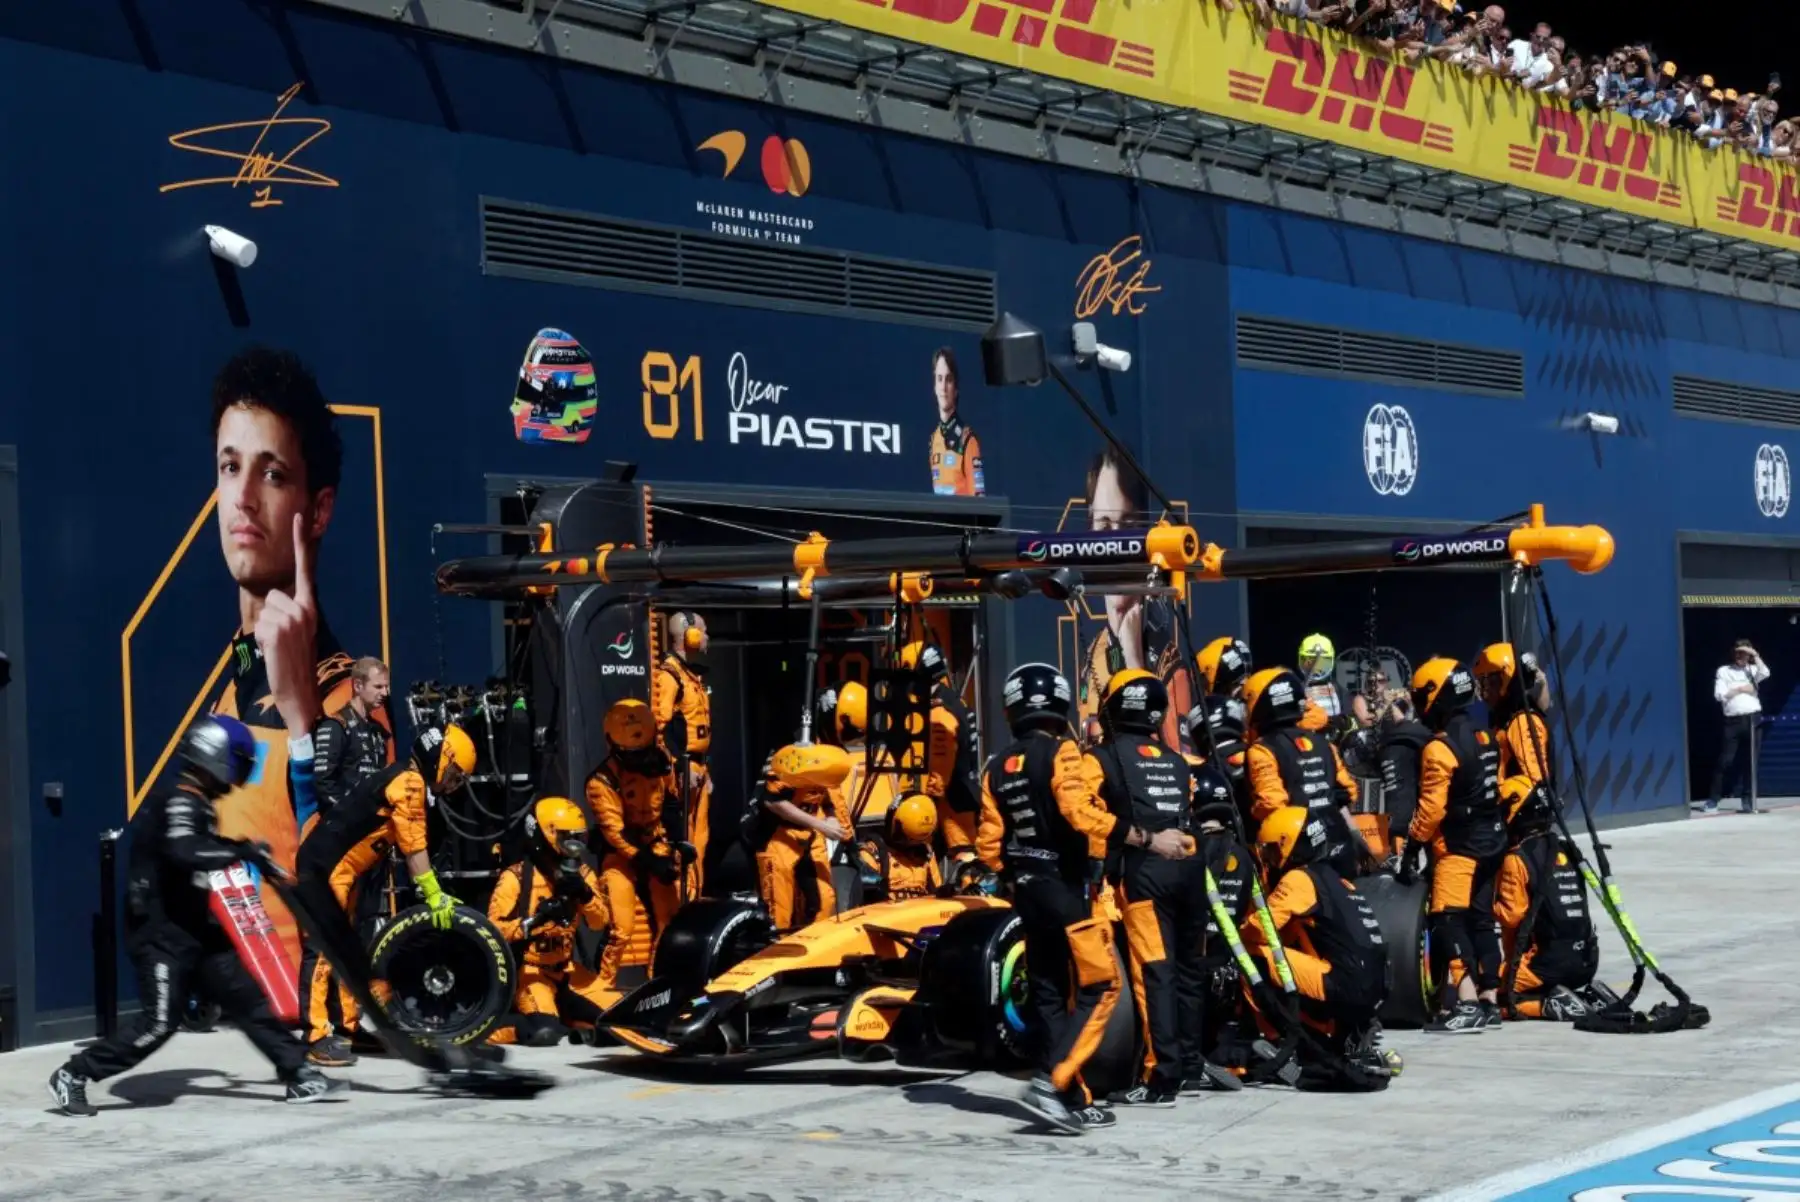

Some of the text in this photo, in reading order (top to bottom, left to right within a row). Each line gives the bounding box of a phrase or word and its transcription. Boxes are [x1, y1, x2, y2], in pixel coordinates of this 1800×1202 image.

[1263, 27, 1426, 144] DHL
[1534, 104, 1661, 202] DHL
[711, 221, 760, 239] FORMULA
[775, 231, 801, 245] TEAM
[749, 209, 814, 231] MASTERCARD
[641, 351, 704, 441] 81
[727, 352, 788, 412] Oscar
[728, 411, 901, 454] PIASTRI
[1050, 540, 1141, 558] DP WORLD
[1422, 539, 1505, 556] DP WORLD
[601, 664, 645, 675] DP WORLD
[459, 915, 508, 985] P ZERO
